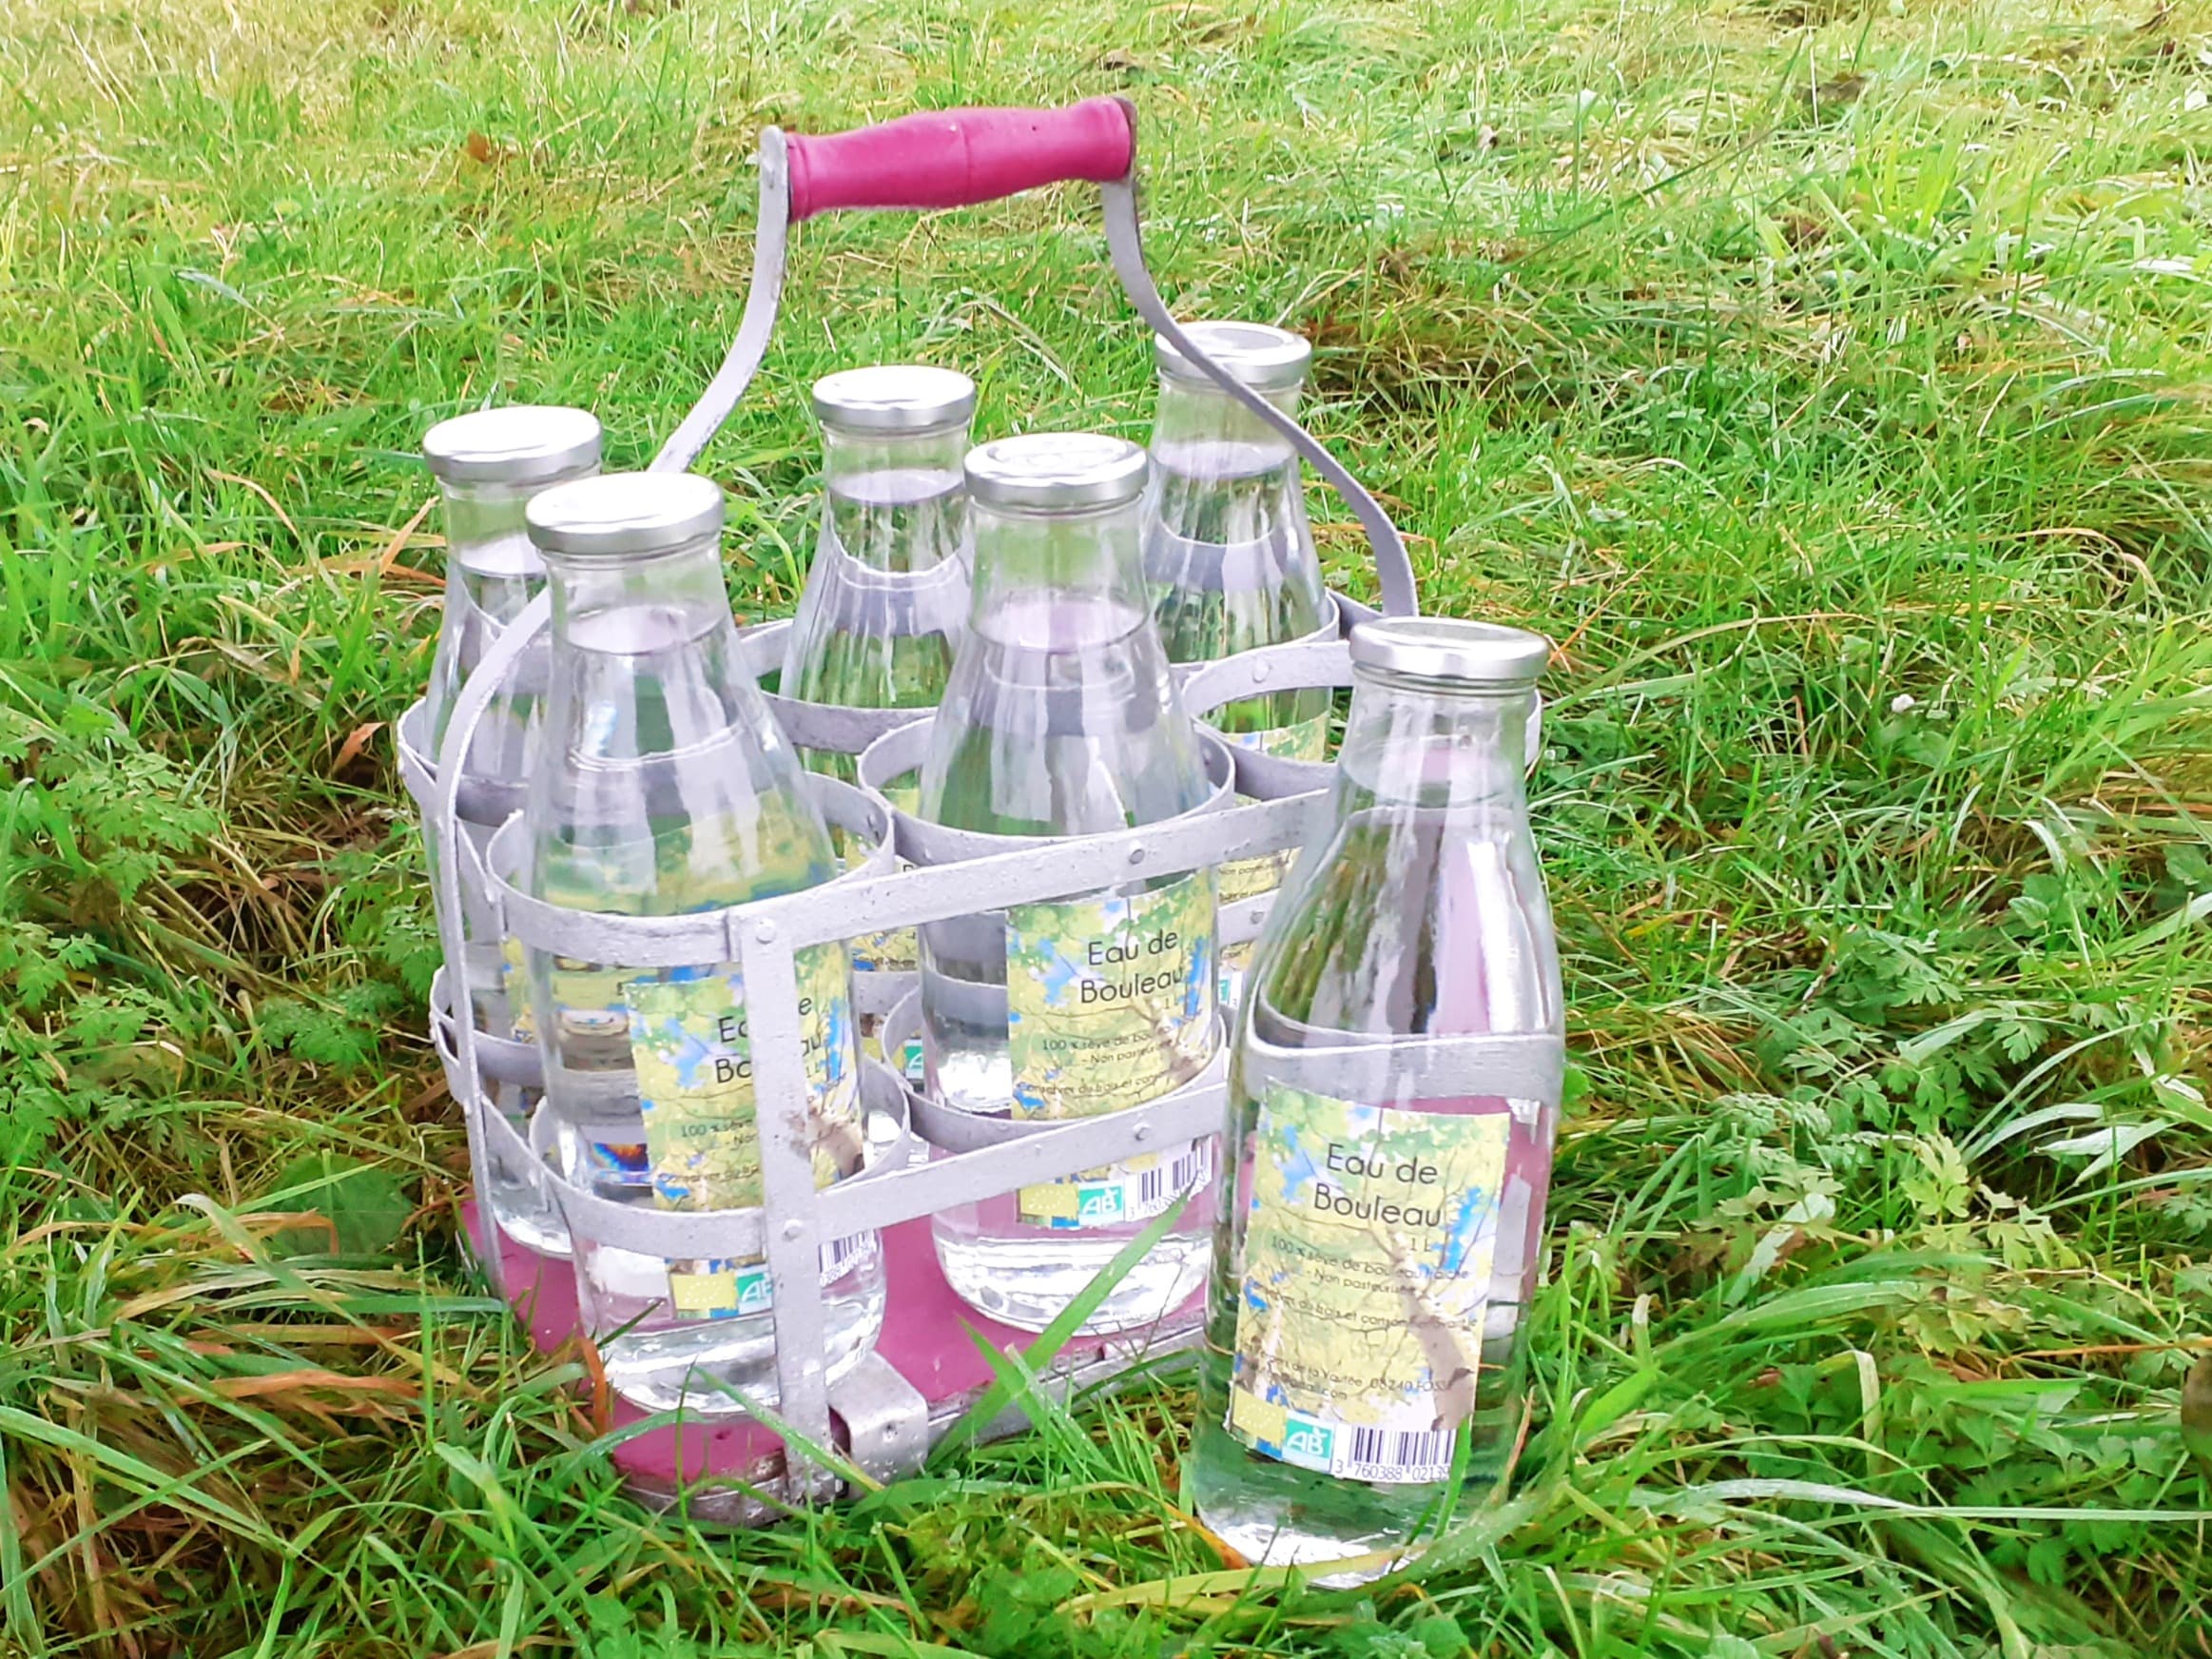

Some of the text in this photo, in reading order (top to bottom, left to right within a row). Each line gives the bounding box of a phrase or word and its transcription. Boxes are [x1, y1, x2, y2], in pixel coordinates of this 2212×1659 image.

[1088, 928, 1178, 966] Eau de
[1080, 966, 1184, 1005] Bouleau
[1042, 1038, 1066, 1051] 100
[682, 1124, 707, 1138] 100
[1327, 1142, 1439, 1185] Eau de
[1082, 1194, 1117, 1215] AB
[1314, 1182, 1442, 1228] Bouleau
[1342, 1258, 1361, 1272] de
[1287, 1431, 1325, 1455] AB
[1335, 1458, 1344, 1474] 3
[1354, 1464, 1403, 1481] 760388
